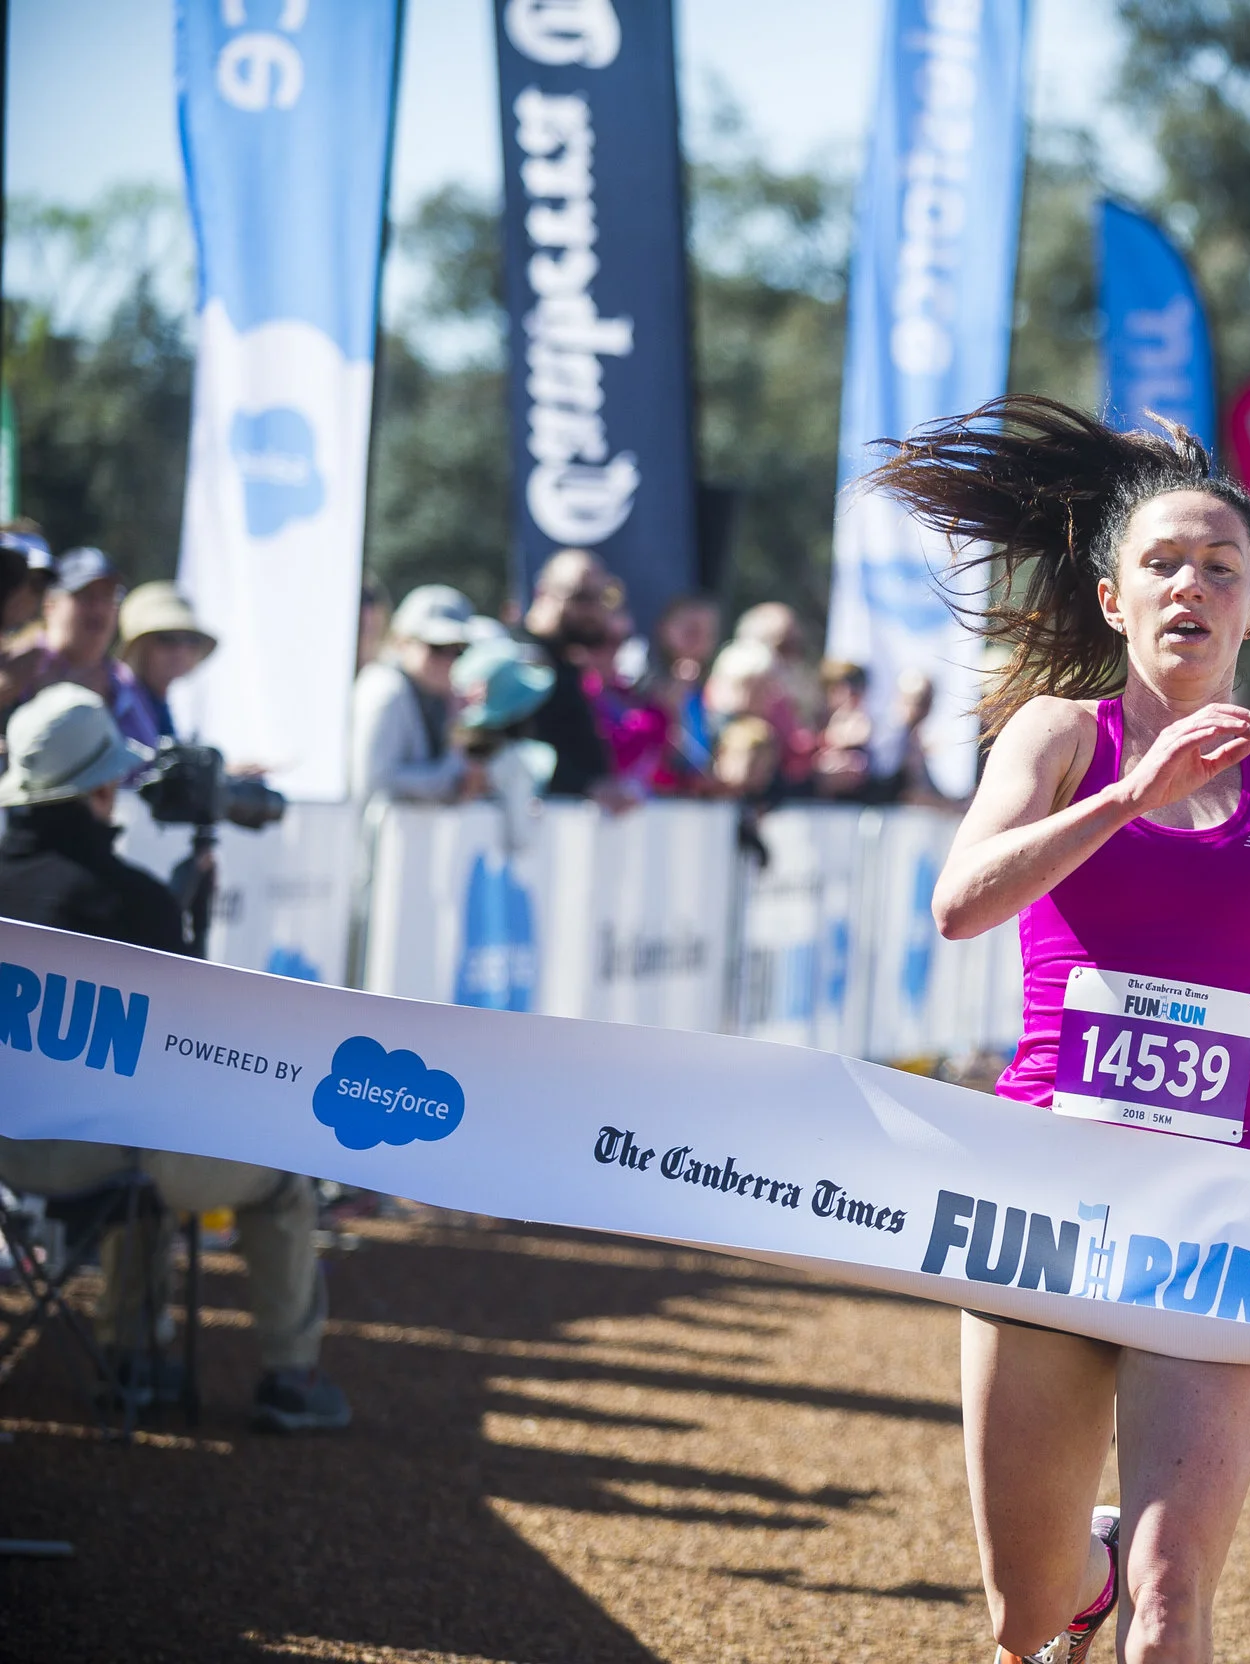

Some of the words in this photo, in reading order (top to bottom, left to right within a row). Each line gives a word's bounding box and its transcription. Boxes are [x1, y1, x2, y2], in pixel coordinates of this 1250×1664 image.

[1123, 994, 1161, 1018] FUN
[1169, 1001, 1207, 1026] RUN
[1127, 978, 1144, 990] The
[1145, 982, 1182, 996] Canberra
[1184, 987, 1209, 1001] Times
[0, 961, 150, 1078] RUN
[164, 1034, 268, 1075] POWERED
[275, 1060, 302, 1083] BY
[1082, 1025, 1231, 1102] 14539
[337, 1077, 449, 1120] salesforce
[1122, 1108, 1145, 1120] 2018
[1152, 1113, 1172, 1125] 5KM
[593, 1125, 656, 1172] The
[660, 1145, 804, 1210] Canberra
[811, 1179, 909, 1235] Times
[920, 1189, 1081, 1295] FUN
